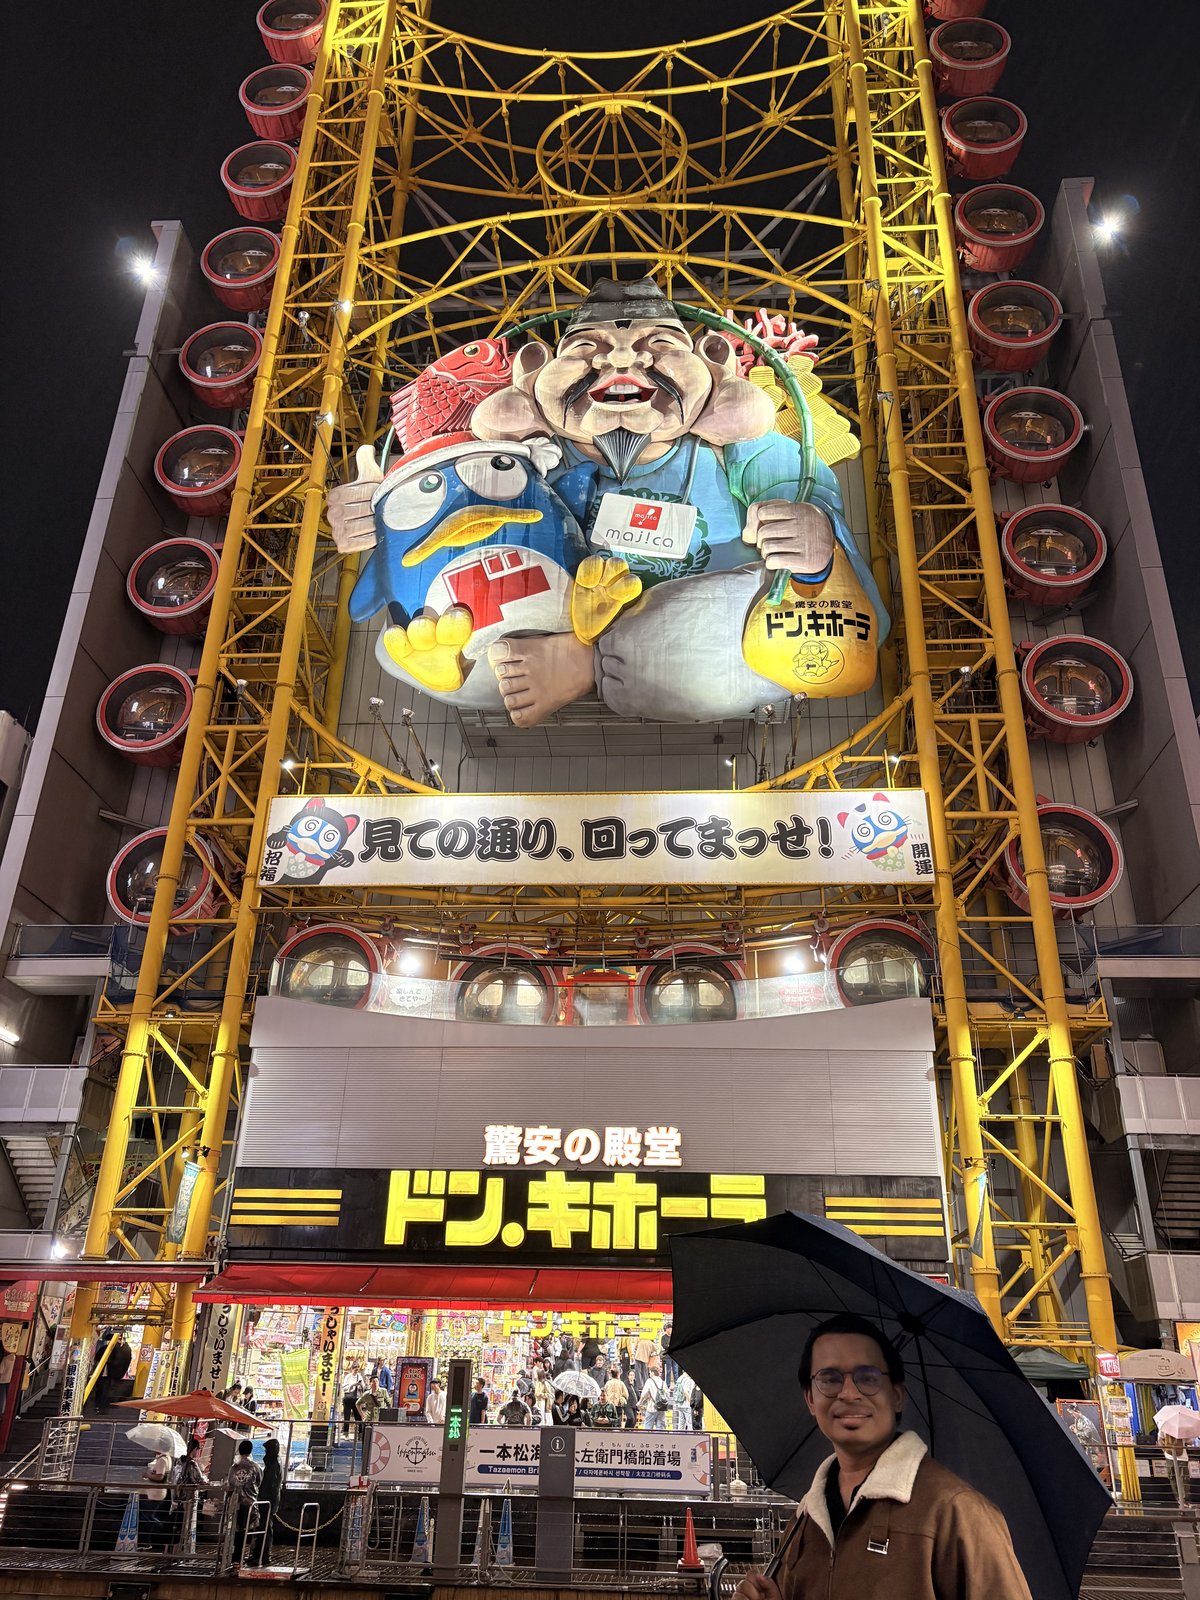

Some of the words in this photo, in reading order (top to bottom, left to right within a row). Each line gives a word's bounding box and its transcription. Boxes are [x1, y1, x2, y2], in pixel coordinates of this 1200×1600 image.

[795, 600, 853, 609] 驚安の殿堂
[358, 816, 835, 862] 見ての通り、回ってまっせ！
[260, 850, 283, 882] 招福
[911, 842, 933, 876] 開運
[482, 1124, 683, 1168] 驚安の殿堂
[449, 1408, 463, 1439] 一本松
[488, 1465, 526, 1474] Tazaemon
